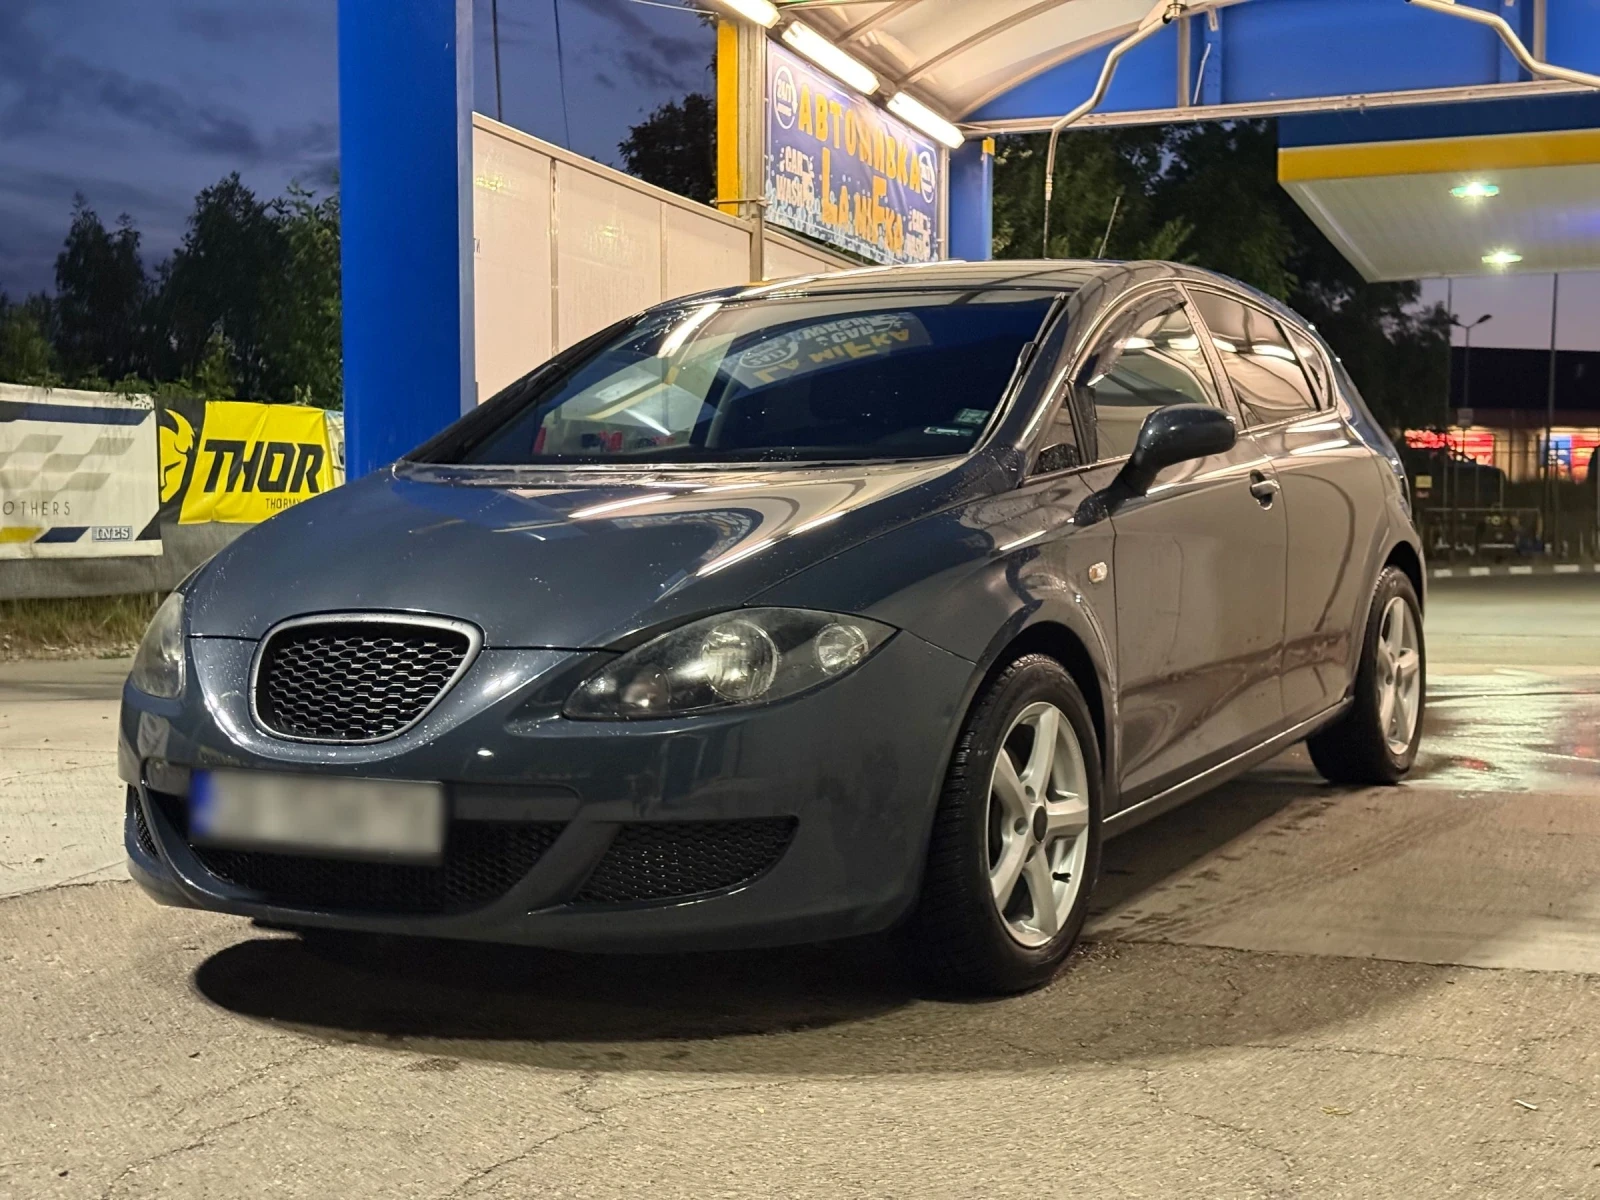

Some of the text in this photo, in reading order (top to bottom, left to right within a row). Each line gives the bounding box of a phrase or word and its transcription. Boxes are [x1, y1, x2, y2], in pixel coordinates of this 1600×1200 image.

[798, 83, 921, 194] АВТОМИВКА
[785, 145, 803, 177] CAR
[776, 174, 803, 208] WASH
[204, 439, 325, 493] THOR
[2, 501, 71, 516] OTHERS
[95, 527, 130, 541] INES
